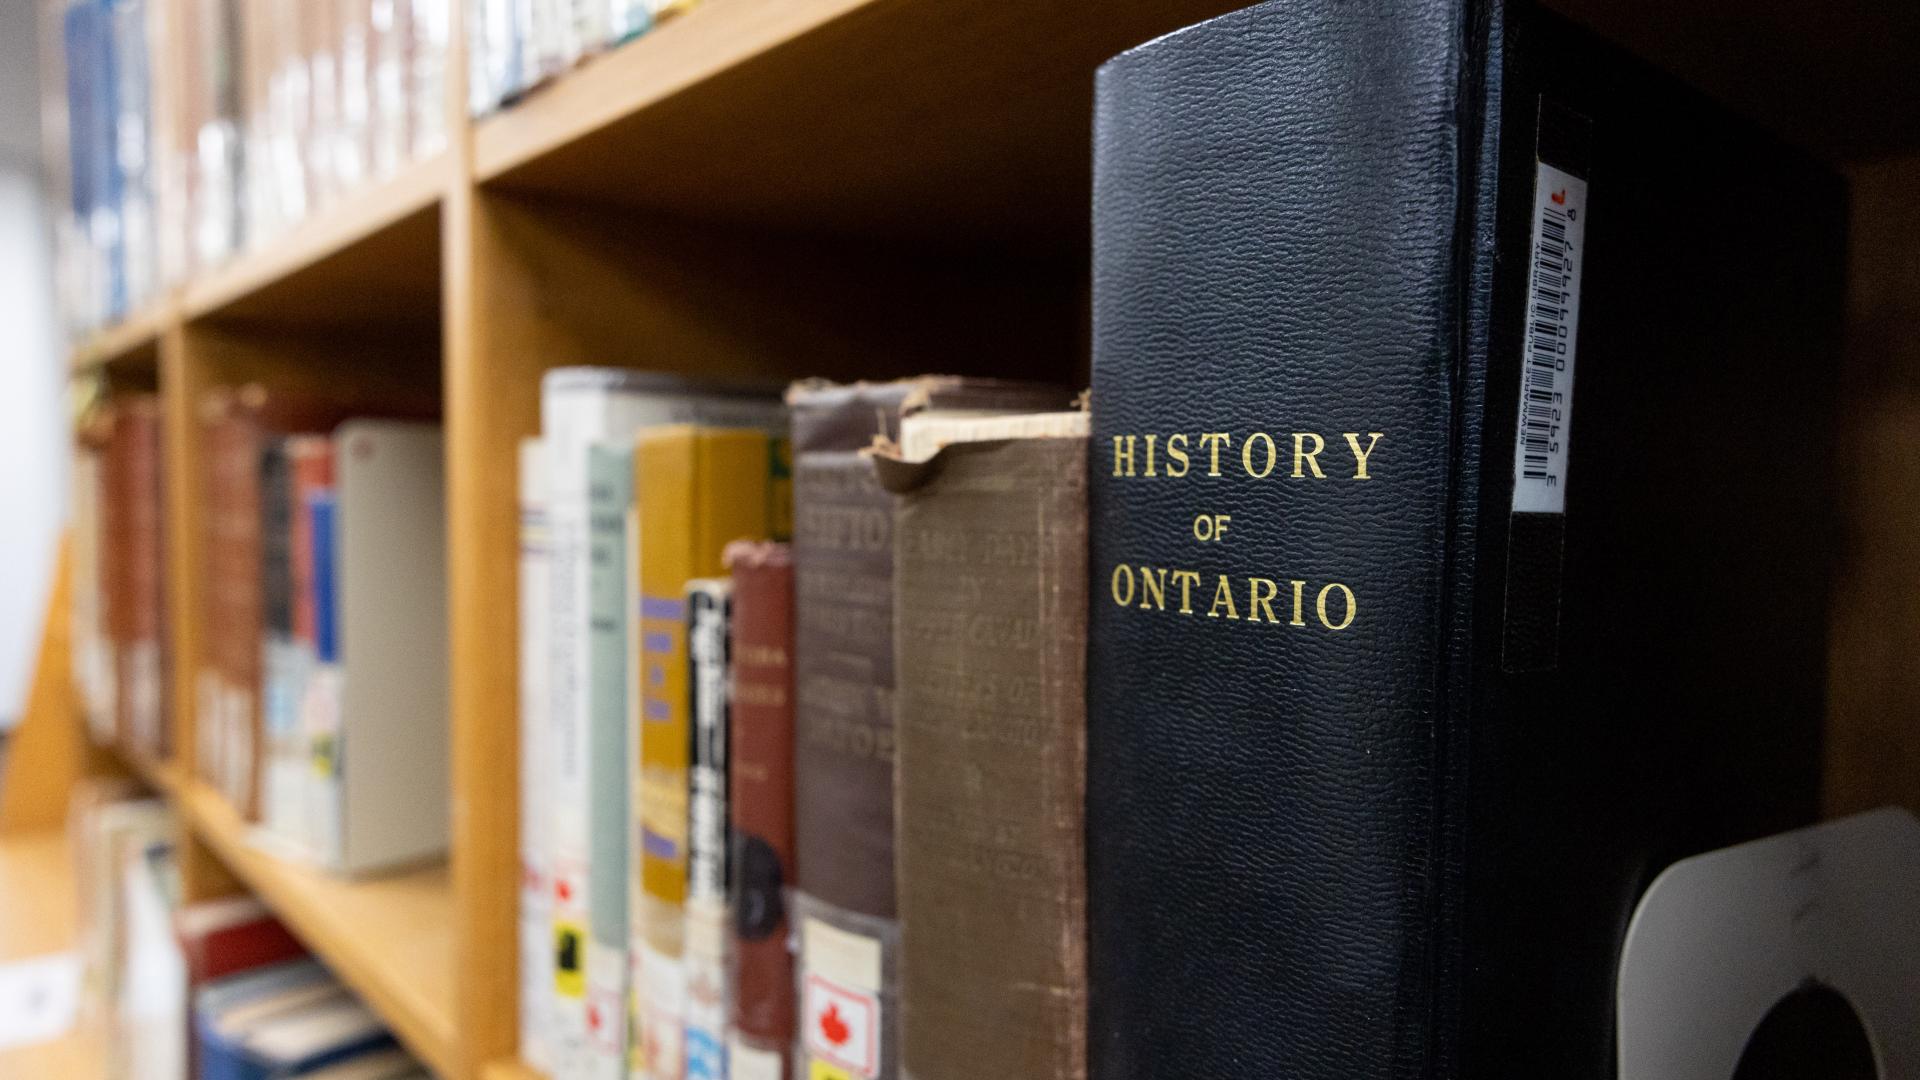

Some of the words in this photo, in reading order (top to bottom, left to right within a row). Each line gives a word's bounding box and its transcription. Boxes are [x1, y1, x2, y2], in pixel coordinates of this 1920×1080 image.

[1567, 209, 1576, 221] 8
[1555, 240, 1574, 373] 00099927
[1521, 359, 1532, 444] NEWMARKET
[1527, 304, 1536, 353] PUBLIC
[1532, 243, 1541, 299] LIBRARY
[1549, 392, 1563, 455] 5923
[1111, 432, 1384, 480] HISTORY
[1547, 475, 1557, 487] 3
[1193, 514, 1231, 541] OF
[1111, 563, 1357, 630] ONTARIO
